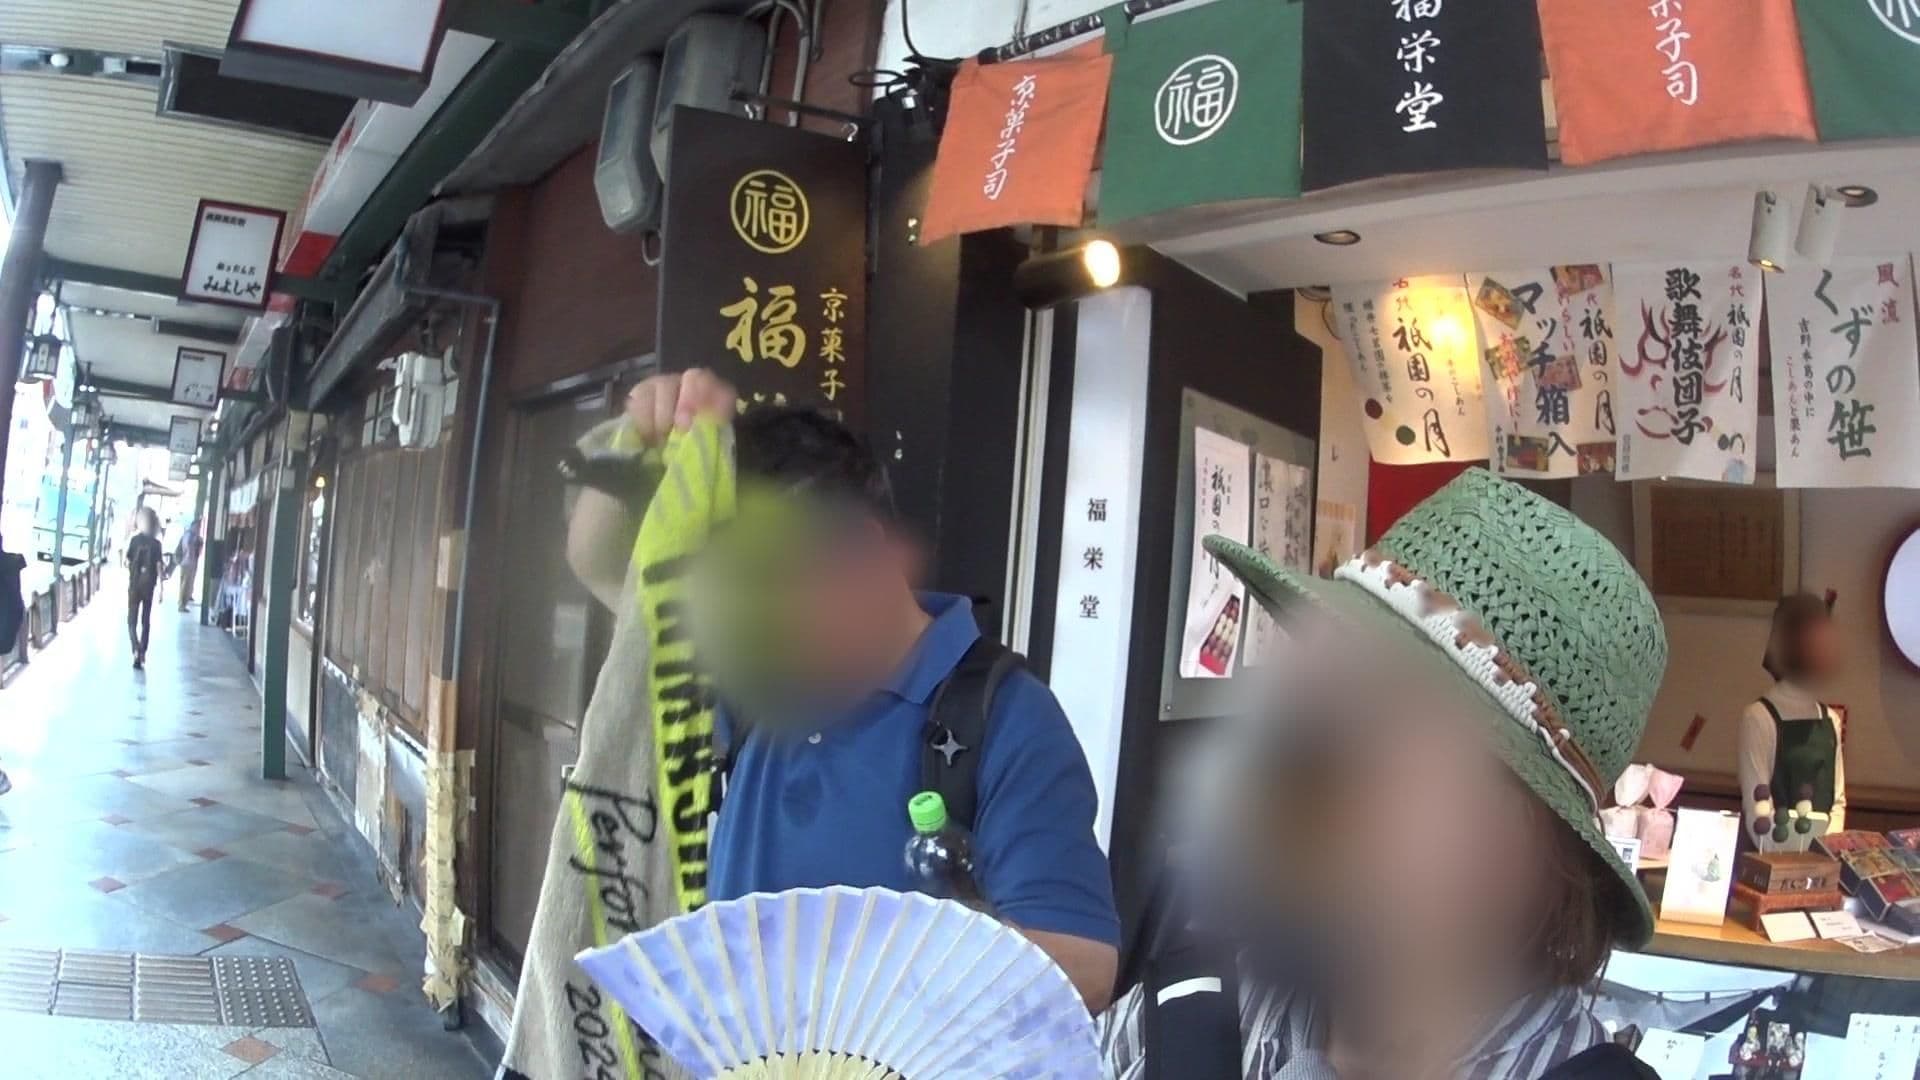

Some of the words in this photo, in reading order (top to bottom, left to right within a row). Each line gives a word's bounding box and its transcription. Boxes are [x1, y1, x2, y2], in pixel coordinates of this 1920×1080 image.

[983, 74, 1037, 201] 京菓子司
[1163, 65, 1226, 137] 福
[741, 178, 798, 246] 福
[819, 287, 848, 422] 京菓子
[1392, 316, 1451, 458] 祇園の月
[1510, 281, 1578, 457] マッチ箱入
[1579, 307, 1617, 436] 祇園の月
[1664, 267, 1706, 446] 歌舞伎団子
[1814, 268, 1876, 461] くずの笹
[1078, 497, 1109, 620] 福栄堂
